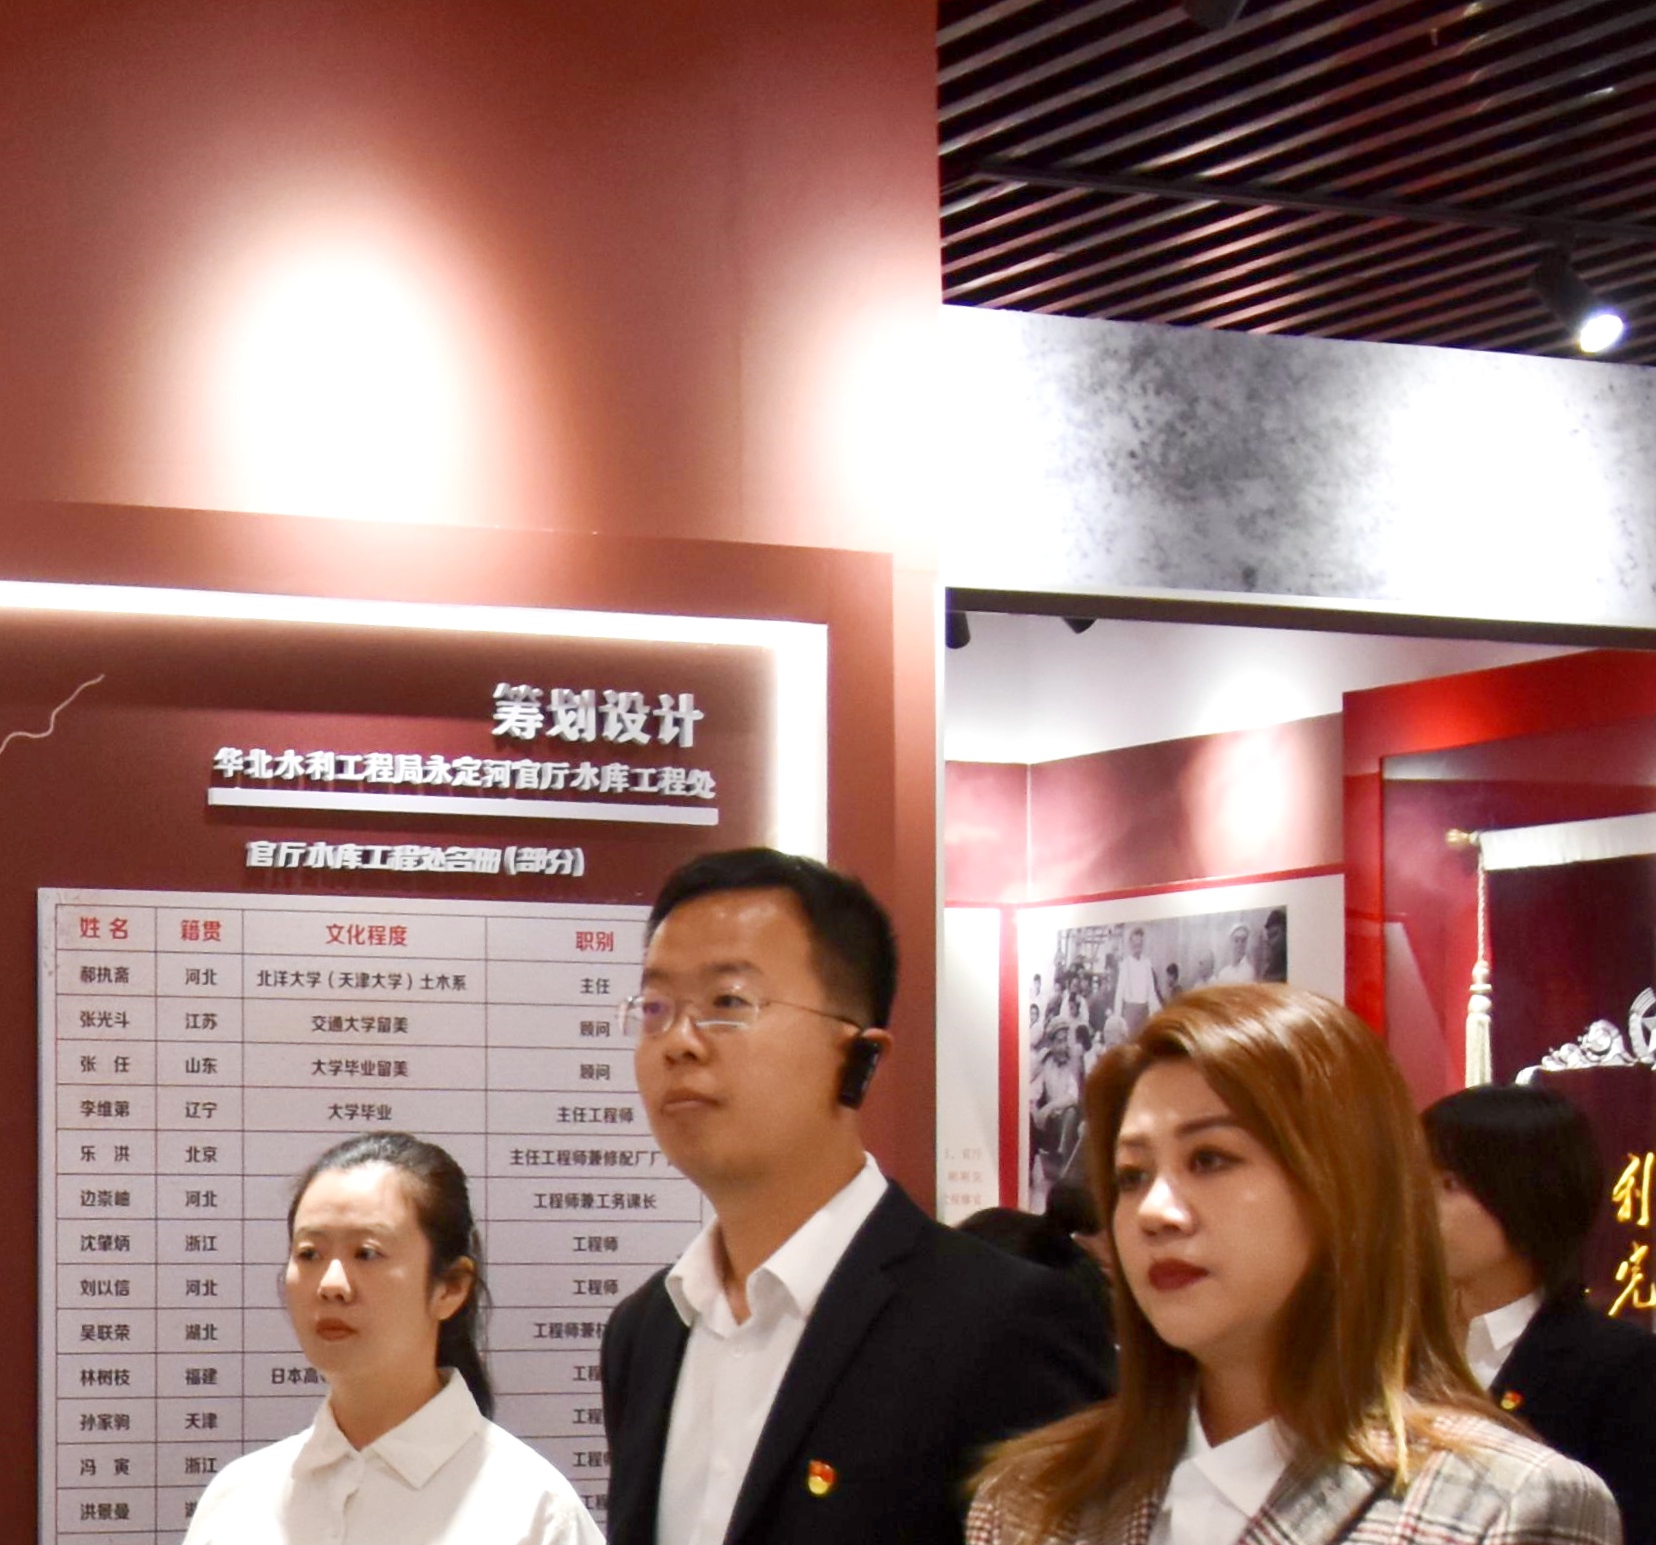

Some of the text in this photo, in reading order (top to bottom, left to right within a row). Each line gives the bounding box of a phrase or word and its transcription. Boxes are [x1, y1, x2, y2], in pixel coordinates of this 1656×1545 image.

[490, 682, 705, 749] 筹划设计
[213, 746, 717, 800] 华北水利工程局永定河官厅水库工程处
[180, 919, 222, 942] 籍贯
[325, 924, 409, 947] 文化程度
[575, 930, 615, 953] 职别
[185, 968, 218, 986] 河北
[257, 970, 468, 992] 北洋大学（天津大学）土木系
[580, 977, 611, 996] 主任
[80, 1010, 130, 1029] 张光斗
[185, 1012, 218, 1030] 江苏
[311, 1015, 409, 1035] 交通大学留美
[580, 1020, 611, 1038] 顾问
[185, 1057, 218, 1075] 山东
[311, 1059, 409, 1079] 大学毕业留美
[579, 1063, 611, 1081] 顾问
[185, 1101, 218, 1119] 辽宁
[327, 1103, 393, 1122] 大学毕业
[556, 1106, 635, 1124] 主任工程师
[185, 1146, 218, 1163] 北京
[509, 1149, 673, 1167] 主任工程师兼修配厂厂
[185, 1190, 218, 1208] 河北
[185, 1235, 218, 1252] 浙江
[572, 1236, 619, 1253] 工程师
[80, 1279, 130, 1297] 刘以信
[185, 1279, 218, 1297] 河北
[572, 1279, 619, 1296] 工程师
[80, 1324, 130, 1342] 吴联荣
[185, 1324, 218, 1341] 湖北
[80, 1369, 130, 1387] 林树枝
[185, 1368, 218, 1386] 福建
[271, 1366, 326, 1385] 日本高
[185, 1412, 218, 1430] 天津
[185, 1457, 218, 1474] 浙江
[80, 1503, 130, 1521] 洪景曼
